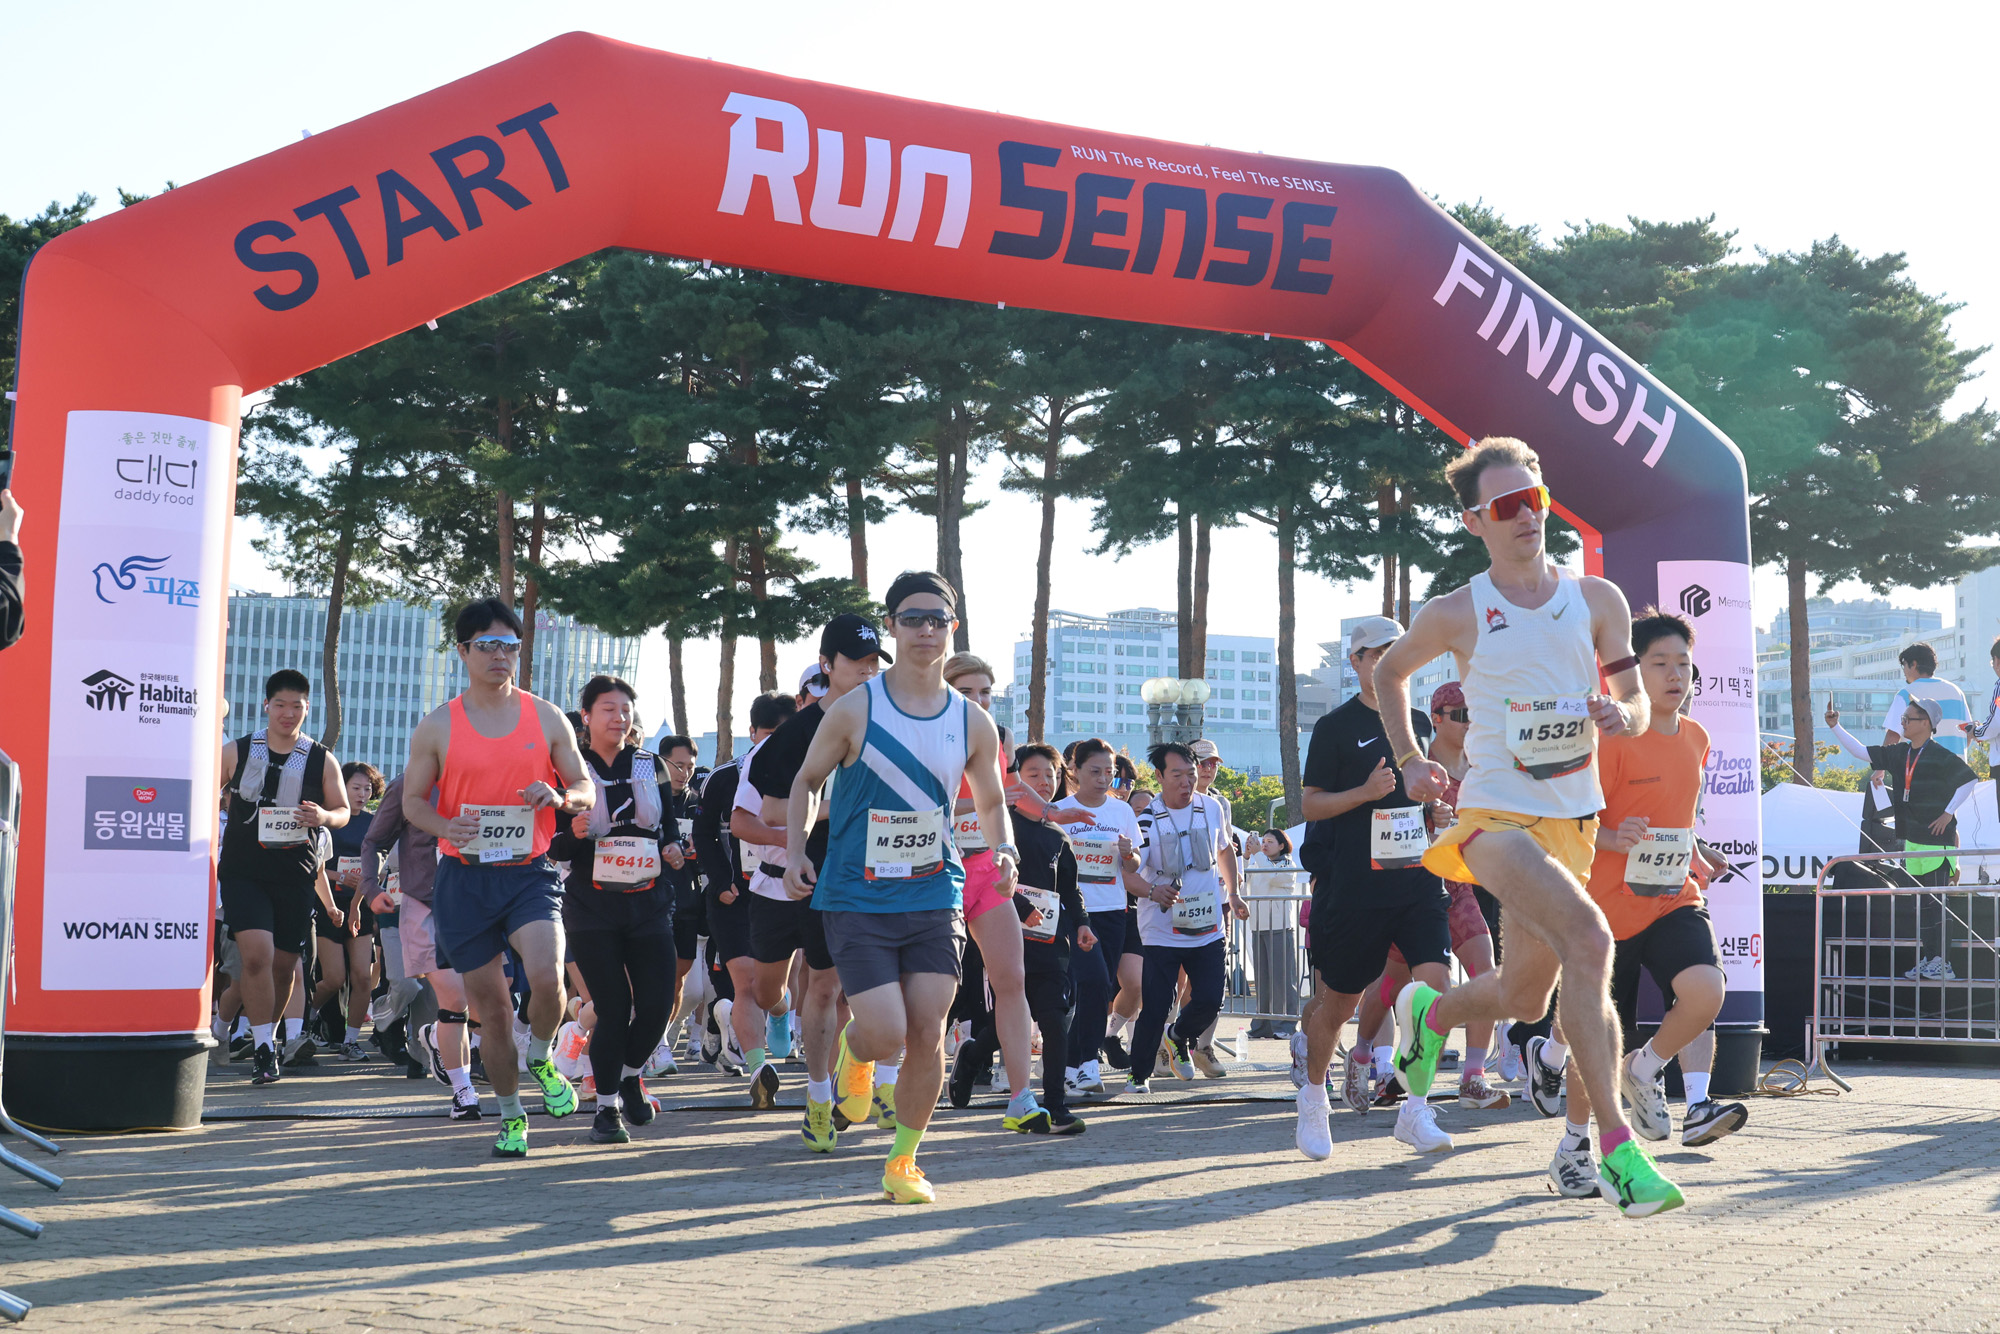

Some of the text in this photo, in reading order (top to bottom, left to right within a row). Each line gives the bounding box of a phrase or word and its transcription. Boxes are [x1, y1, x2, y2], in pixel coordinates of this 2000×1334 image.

[1070, 145, 1336, 194] RUN The Record, Feel The SENSE
[234, 102, 570, 312] START
[988, 140, 1338, 295] SENSE
[1432, 241, 1677, 469] FINISH
[122, 431, 197, 452] 좋은 것만 줄게
[116, 454, 198, 489] 대디
[114, 488, 194, 506] daddy food
[143, 577, 200, 608] 피죤
[140, 672, 180, 683] 한국해비타트
[139, 683, 198, 705] Habitat
[139, 703, 198, 717] for Humanity
[138, 715, 161, 725] Korea
[1519, 718, 1586, 741] M 5321
[1531, 743, 1560, 754] Dominik
[1704, 750, 1752, 771] Choco
[1704, 770, 1755, 795] Health
[480, 809, 505, 817] SENSE
[890, 815, 918, 824] SENSE
[1390, 812, 1410, 820] SENSE
[93, 810, 186, 841] 동원샘물
[482, 826, 525, 839] 5070
[1094, 822, 1120, 834] Saisons
[877, 836, 889, 847] M
[892, 831, 937, 849] 5339
[1380, 827, 1424, 842] M 5128
[1655, 833, 1679, 842] SENSE
[1085, 841, 1103, 849] SENSE
[1706, 839, 1758, 856] eebok
[484, 850, 509, 859] B-211
[602, 855, 654, 868] W 6412
[1085, 853, 1114, 865] 6428
[1638, 853, 1652, 863] M
[879, 866, 903, 874] B-230
[1179, 905, 1213, 918] M 5314
[63, 922, 199, 940] WOMAN SENSE
